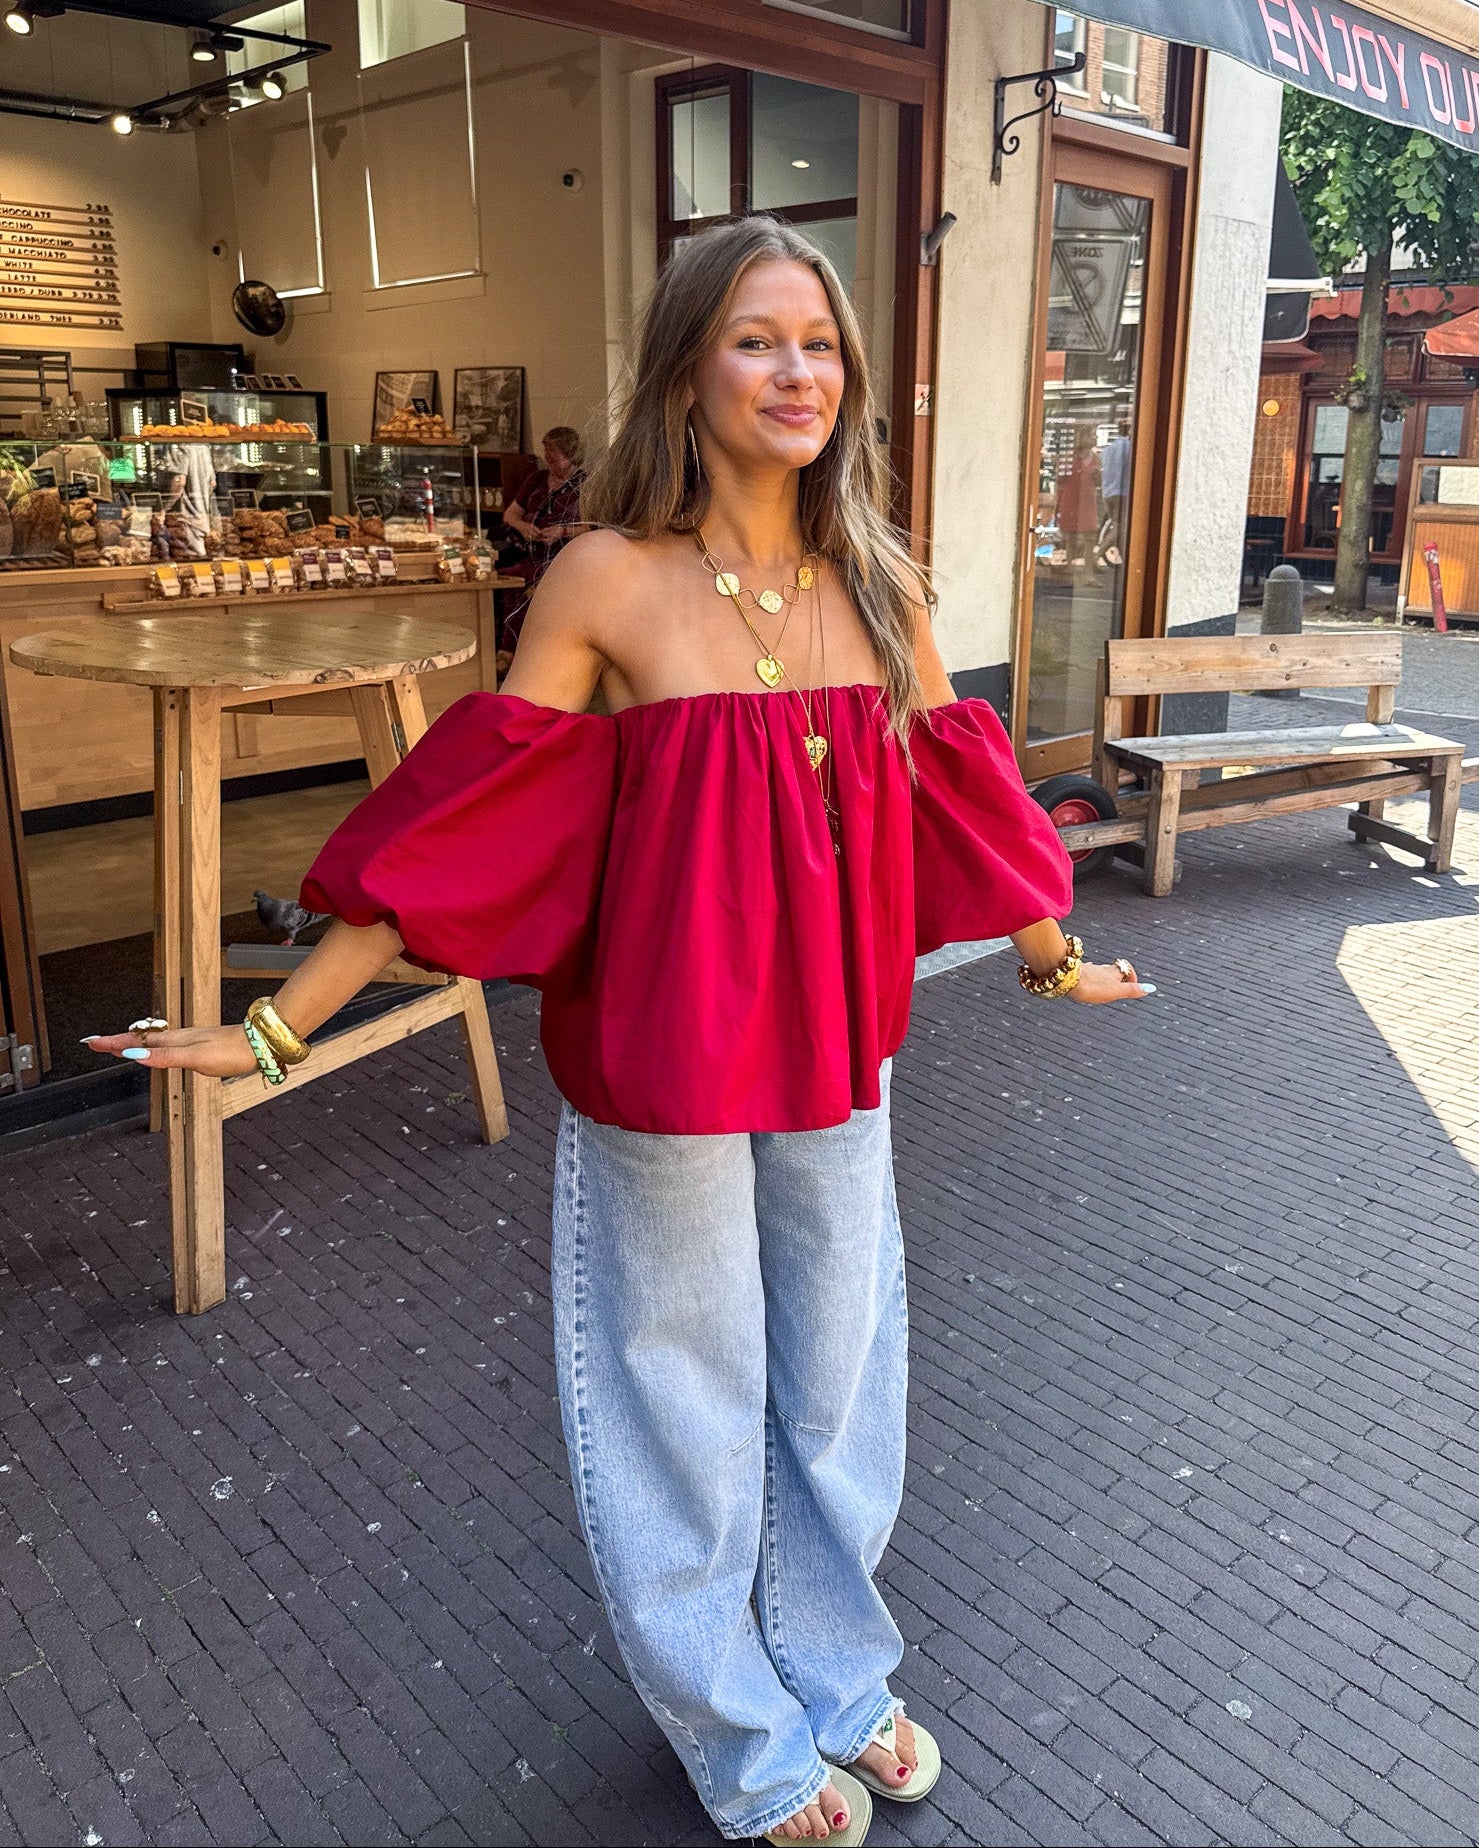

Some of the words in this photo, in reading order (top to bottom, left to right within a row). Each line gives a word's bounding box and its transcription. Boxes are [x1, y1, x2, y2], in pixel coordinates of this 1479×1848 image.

[1258, 0, 1409, 109] ENJOY
[0, 207, 51, 218] HOCOLATE
[11, 235, 74, 247] CAPPUCCINO
[8, 247, 67, 259] MACCHIATO
[4, 260, 33, 269] WHITE
